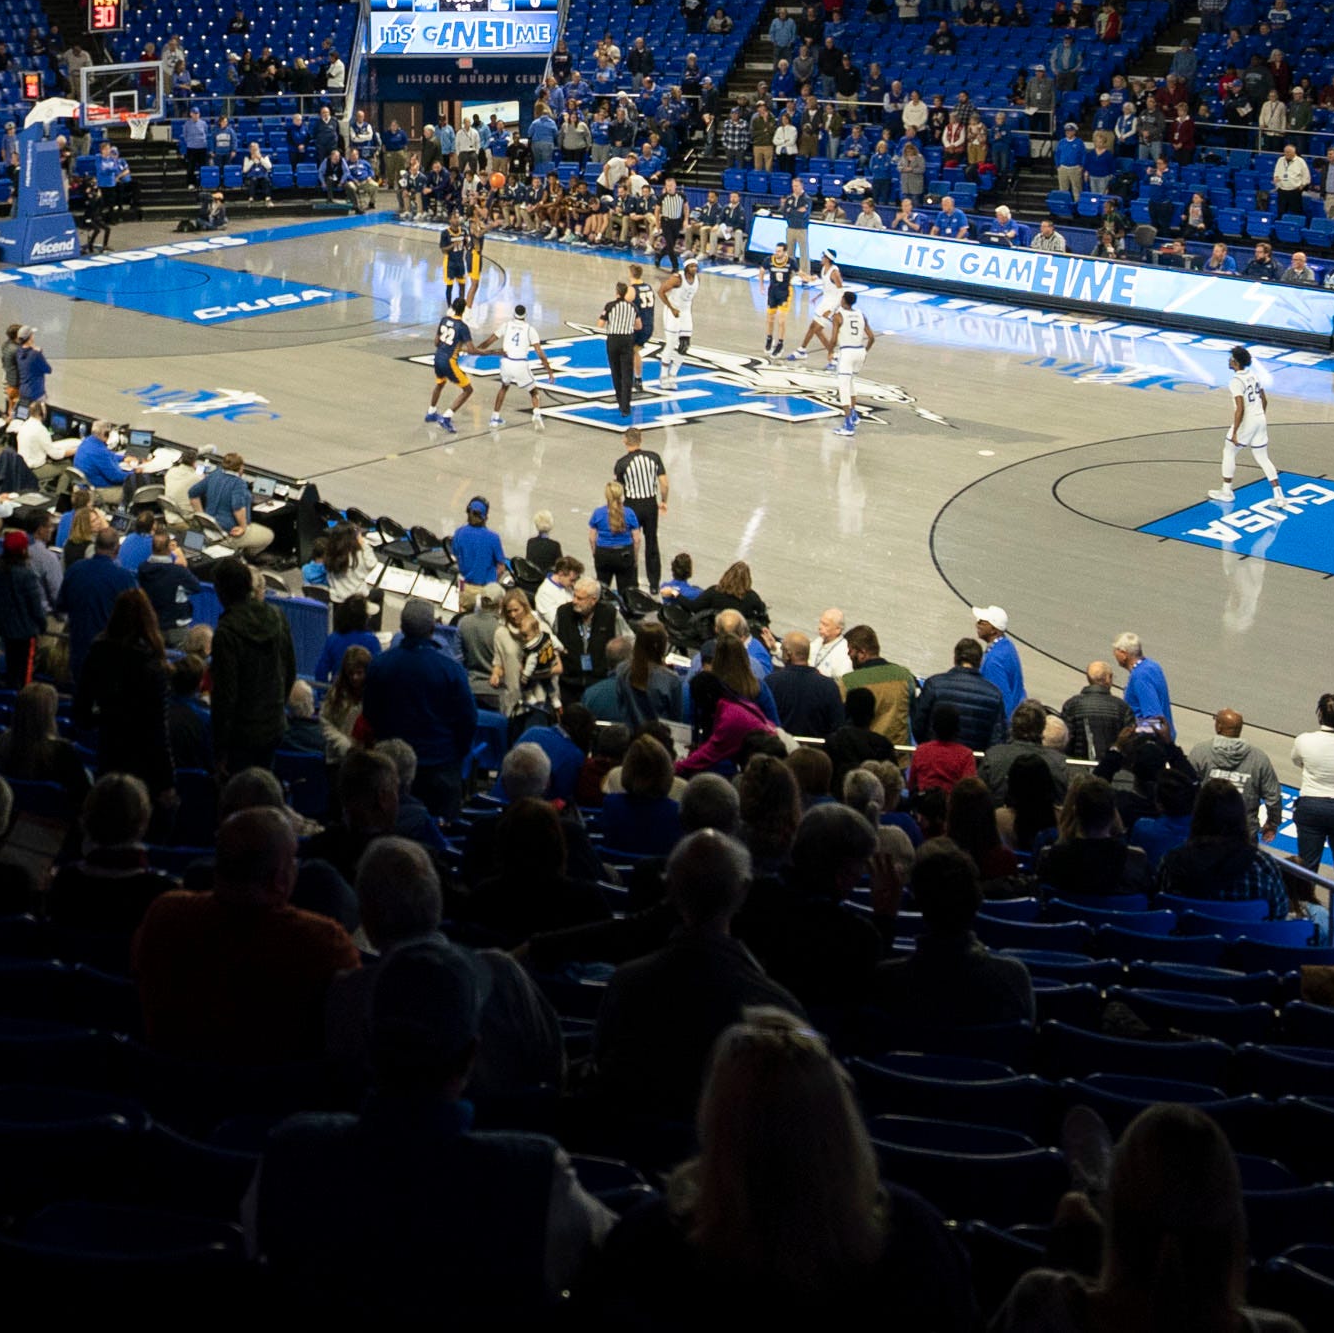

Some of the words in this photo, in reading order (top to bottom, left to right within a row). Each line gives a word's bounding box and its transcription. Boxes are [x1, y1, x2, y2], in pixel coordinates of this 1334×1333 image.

[94, 6, 116, 28] 30
[398, 74, 453, 85] HISTORIC
[459, 74, 508, 84] MURPHY
[515, 75, 545, 85] CENT
[17, 236, 249, 275] RAIDERS
[30, 237, 75, 255] Ascend
[903, 244, 946, 271] ITS
[639, 289, 655, 309] 33
[438, 326, 457, 346] 22
[850, 320, 859, 336] 5
[511, 332, 521, 347] 4
[1247, 382, 1262, 403] 24
[1209, 768, 1252, 784] BEST
